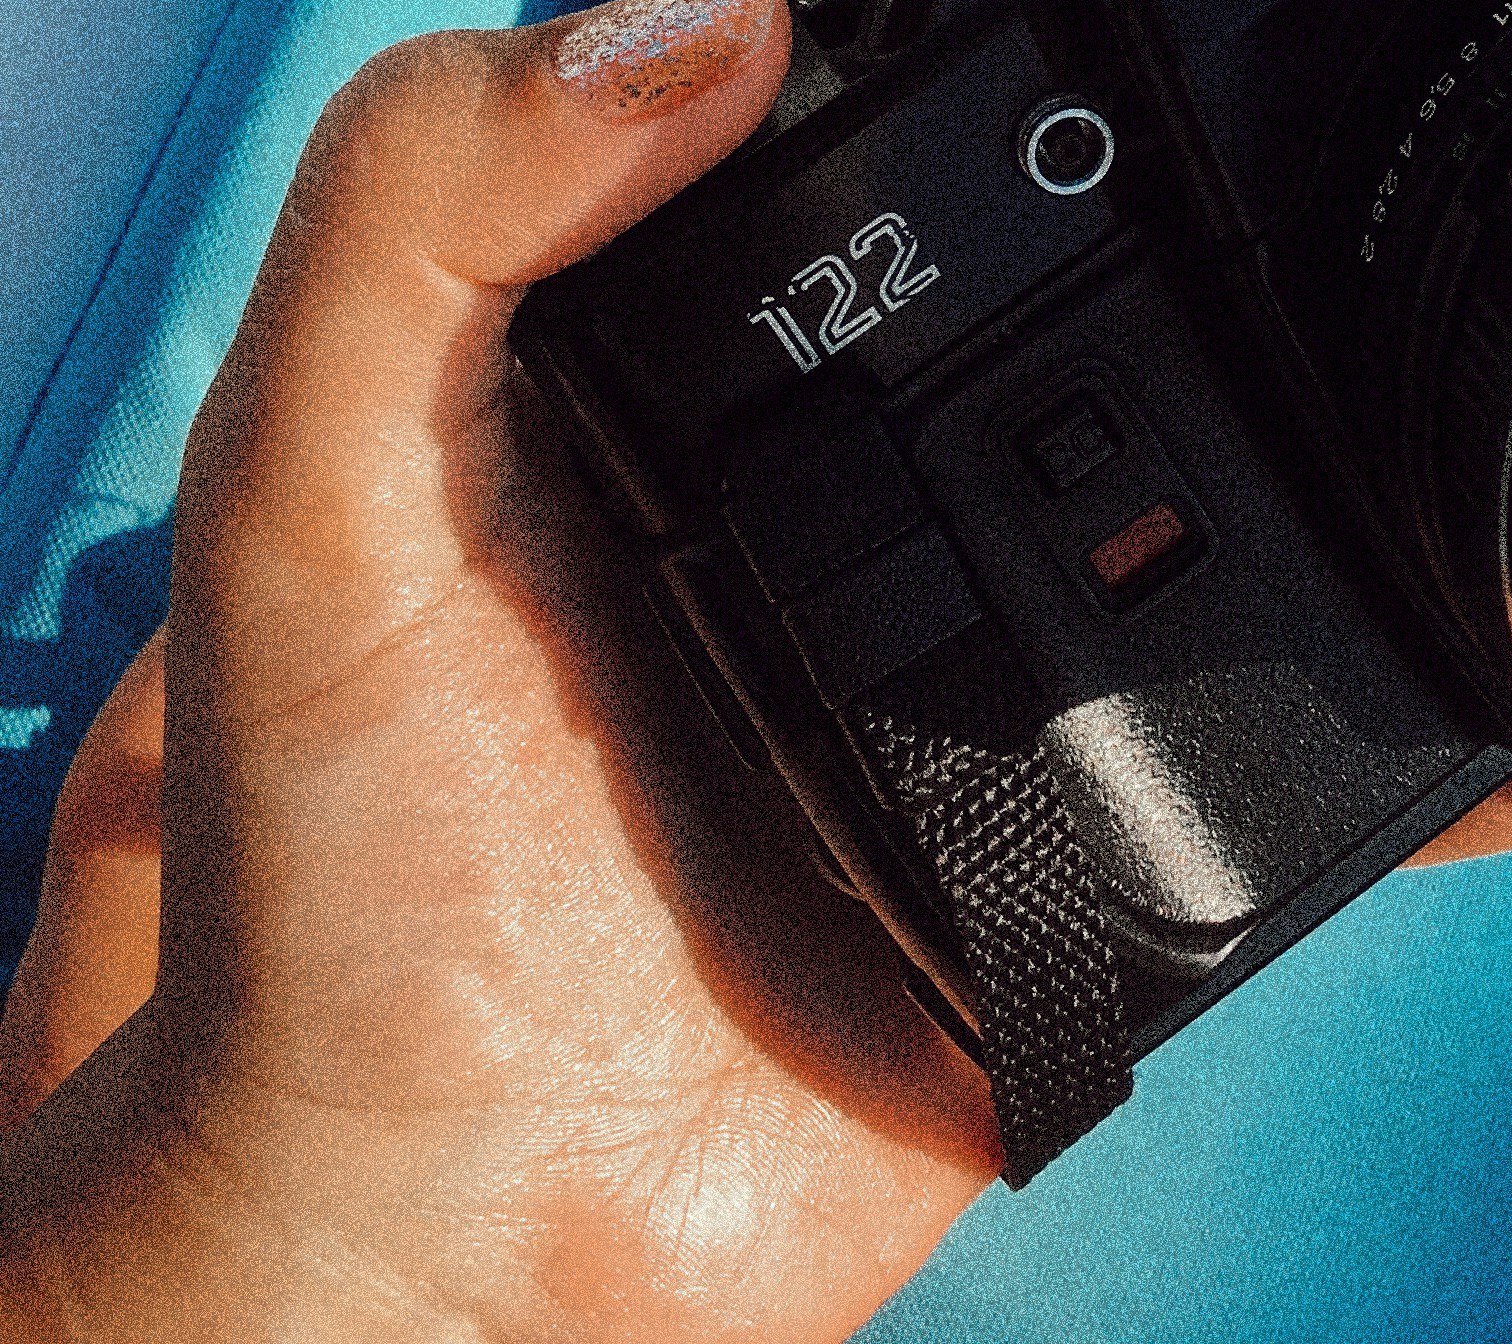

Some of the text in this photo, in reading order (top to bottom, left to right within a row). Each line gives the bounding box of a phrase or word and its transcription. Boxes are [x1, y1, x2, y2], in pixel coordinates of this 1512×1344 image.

[1459, 41, 1480, 63] 8
[1418, 71, 1456, 123] 5,6
[1398, 131, 1414, 159] 4
[1359, 233, 1376, 263] 2
[747, 212, 942, 374] 122
